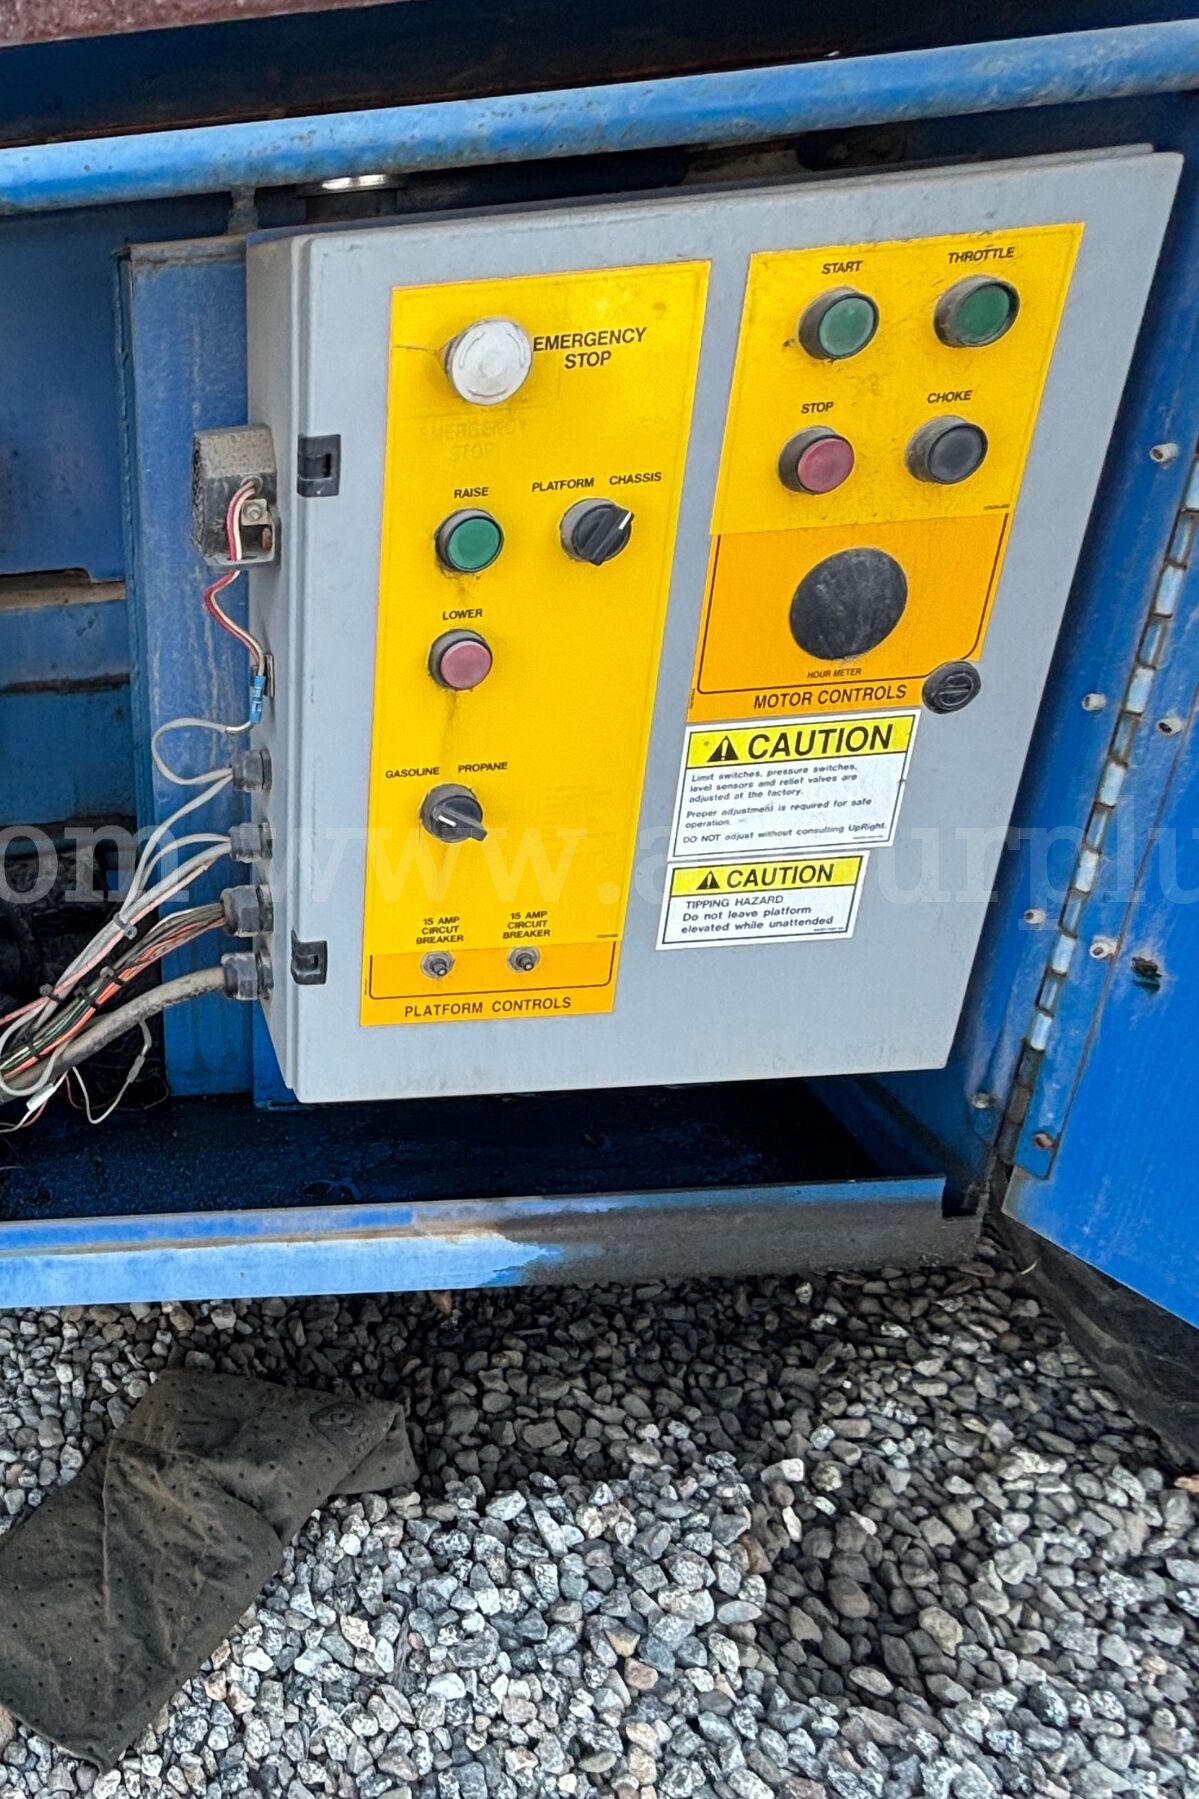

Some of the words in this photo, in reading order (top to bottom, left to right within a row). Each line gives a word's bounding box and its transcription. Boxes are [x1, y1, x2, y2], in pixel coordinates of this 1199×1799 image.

[948, 247, 1015, 263] THROTTLE
[822, 260, 863, 274] START
[532, 327, 647, 351] EMERGENCY
[564, 351, 611, 370] STOP
[927, 390, 972, 404] CHOKE
[801, 402, 834, 414] STOP
[532, 477, 594, 492] PLATFORM
[609, 472, 662, 486] CHASSIS
[454, 486, 489, 499] RAISE
[442, 608, 483, 621] LOWER
[807, 670, 832, 679] HOUR
[833, 668, 862, 677] METER
[754, 688, 812, 709] MOTOR
[818, 684, 907, 705] CONTROLS
[748, 724, 893, 759] CAUTION
[385, 767, 440, 779] GASOLINE
[458, 761, 508, 773] PROPANE
[692, 773, 714, 782] Limit
[766, 767, 808, 777] pressure
[690, 784, 712, 793] level
[716, 782, 754, 790] sensors
[758, 779, 776, 787] and
[779, 777, 804, 786] relief
[808, 775, 837, 783] valves
[689, 793, 730, 803] adjusted
[686, 810, 717, 819] Proper
[721, 804, 774, 816] adjustment
[778, 804, 786, 812] is
[790, 801, 829, 811] required
[851, 798, 872, 806] safe
[683, 836, 698, 844] DO
[701, 834, 721, 842] NOT
[724, 832, 754, 841] adjust
[758, 829, 792, 838] without
[727, 863, 834, 888] CAUTION
[686, 899, 730, 909] TIPPING
[735, 895, 784, 906] HAZARD
[423, 917, 433, 925] 15
[438, 916, 460, 924] AMP
[511, 912, 521, 920] 15
[525, 910, 548, 919] AMP
[683, 912, 699, 922] Do
[704, 910, 723, 920] not
[728, 909, 758, 918] leave
[763, 906, 812, 917] platform
[422, 925, 460, 935] CIRCUT
[507, 920, 548, 929] CIRCUIT
[681, 923, 729, 934] elevated
[735, 921, 764, 930] while
[769, 916, 834, 928] unattended
[416, 934, 464, 945] BREAKER
[503, 929, 551, 939] BREAKER
[404, 1001, 483, 1018] PLATFORM
[492, 996, 571, 1013] CONTROLS
